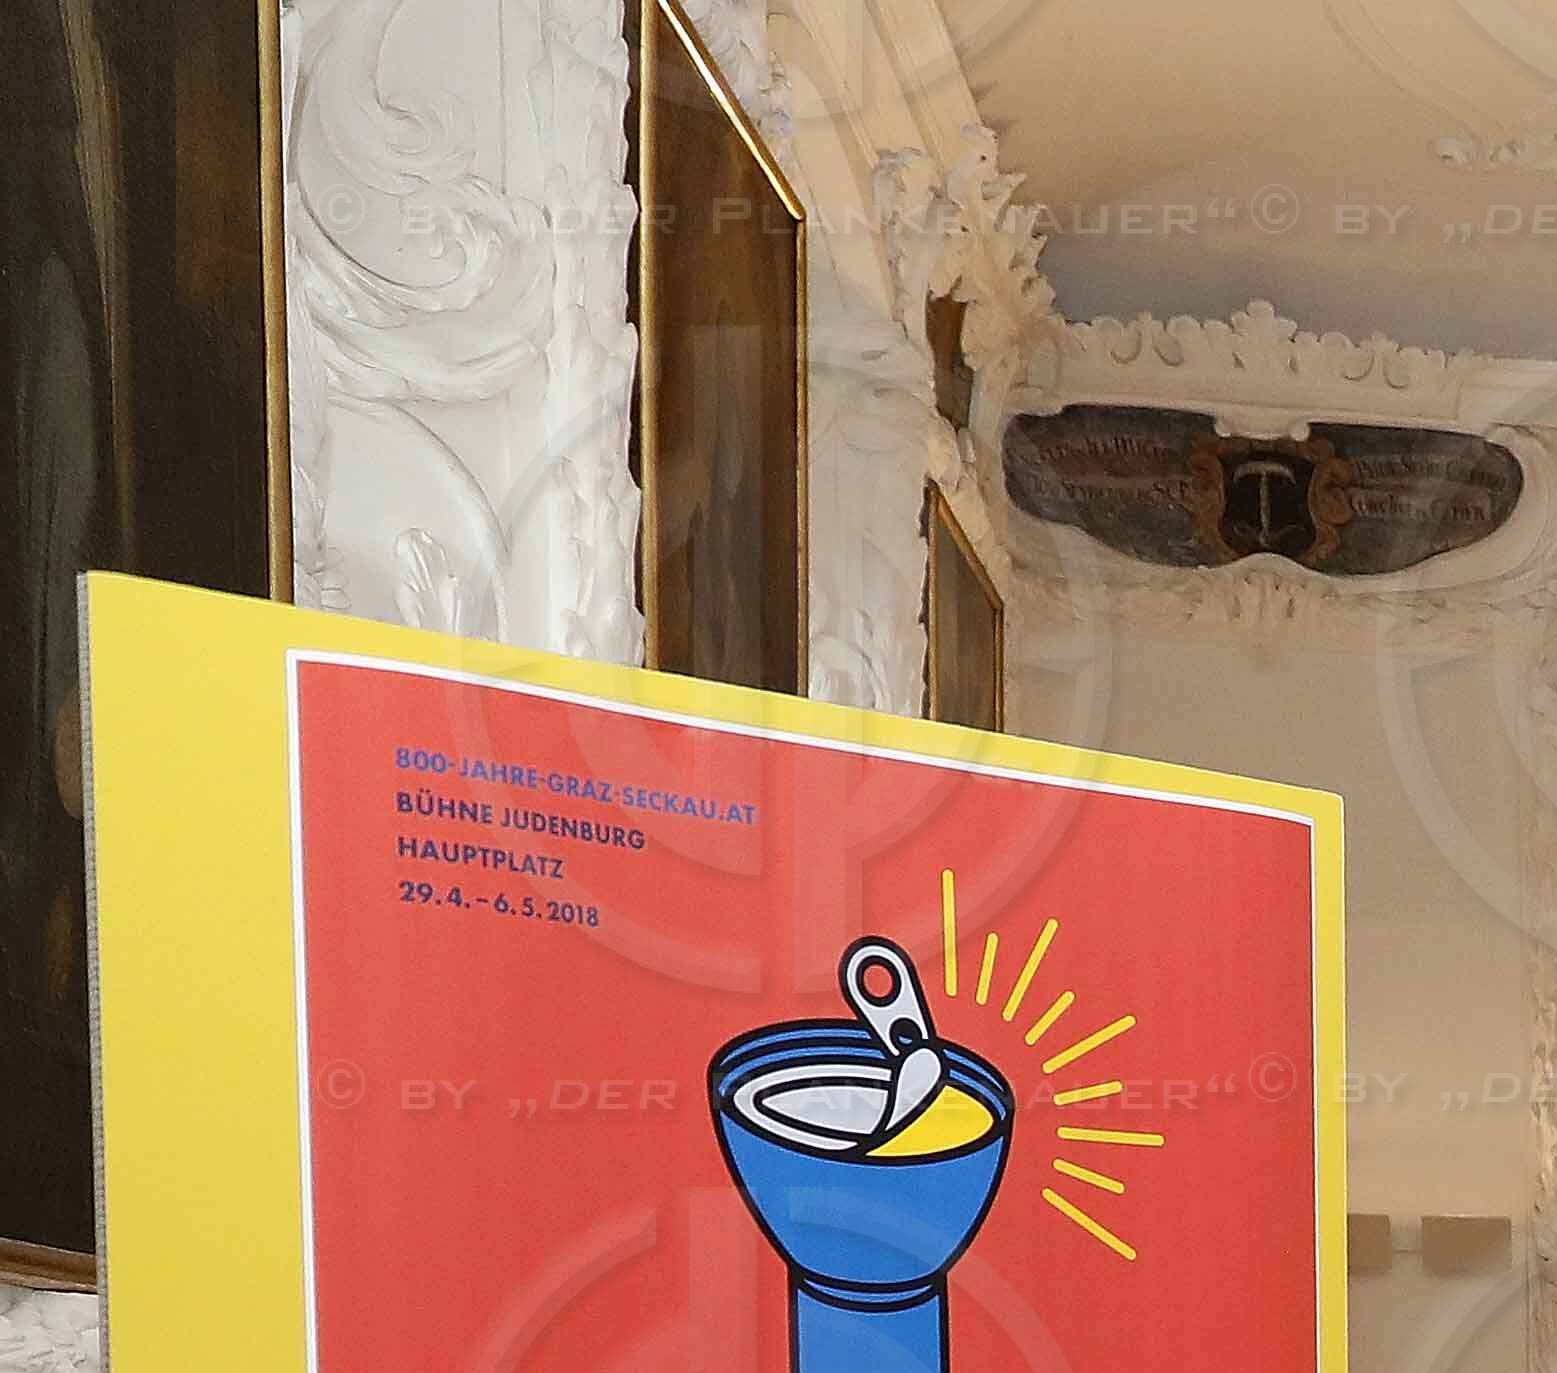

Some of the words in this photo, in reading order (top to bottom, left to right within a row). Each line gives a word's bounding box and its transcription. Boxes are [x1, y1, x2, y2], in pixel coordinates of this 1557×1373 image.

[395, 745, 758, 826] 800-JAHRE-GRAZ-SECKAU.AT
[396, 790, 494, 825] BÜHNE
[500, 803, 647, 851] JUDENBURG
[397, 836, 565, 880] HAUPTPLATZ
